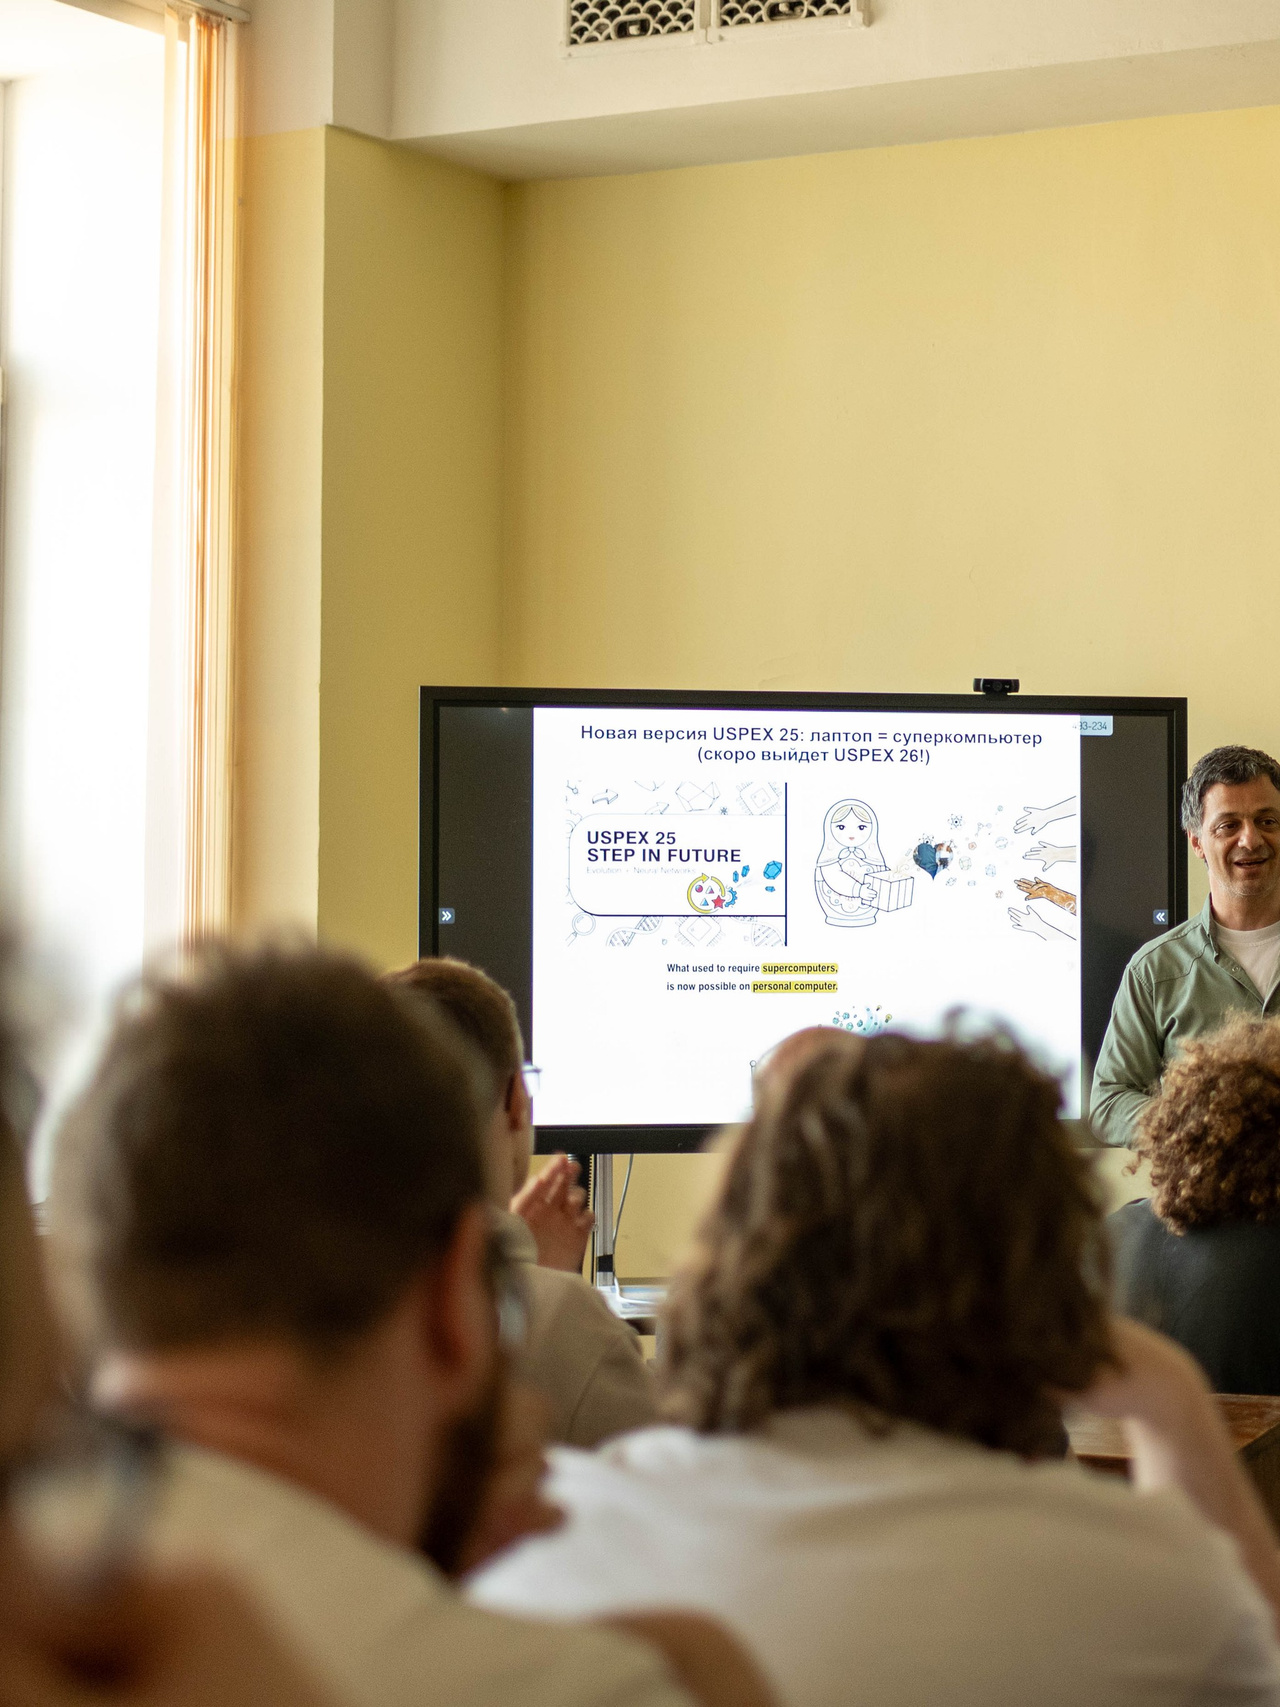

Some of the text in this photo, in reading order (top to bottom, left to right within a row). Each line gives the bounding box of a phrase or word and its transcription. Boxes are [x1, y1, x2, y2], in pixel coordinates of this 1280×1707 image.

[581, 725, 637, 740] Новая
[643, 728, 707, 743] версия
[713, 727, 774, 742] USPEX
[779, 728, 804, 742] 25:
[810, 731, 873, 743] лаптоп
[893, 732, 1042, 747] суперкомпьютер
[697, 746, 931, 765] (скоро выйдет USPEX 26!)
[587, 831, 676, 845] USPEX 25
[587, 848, 741, 862] STEP IN FUTURE
[586, 867, 622, 875] Evolution
[667, 963, 838, 974] What used to require supercomputers,
[667, 982, 675, 990] is
[698, 982, 737, 992] possible
[753, 982, 792, 993] personal
[794, 983, 838, 992] computer.
